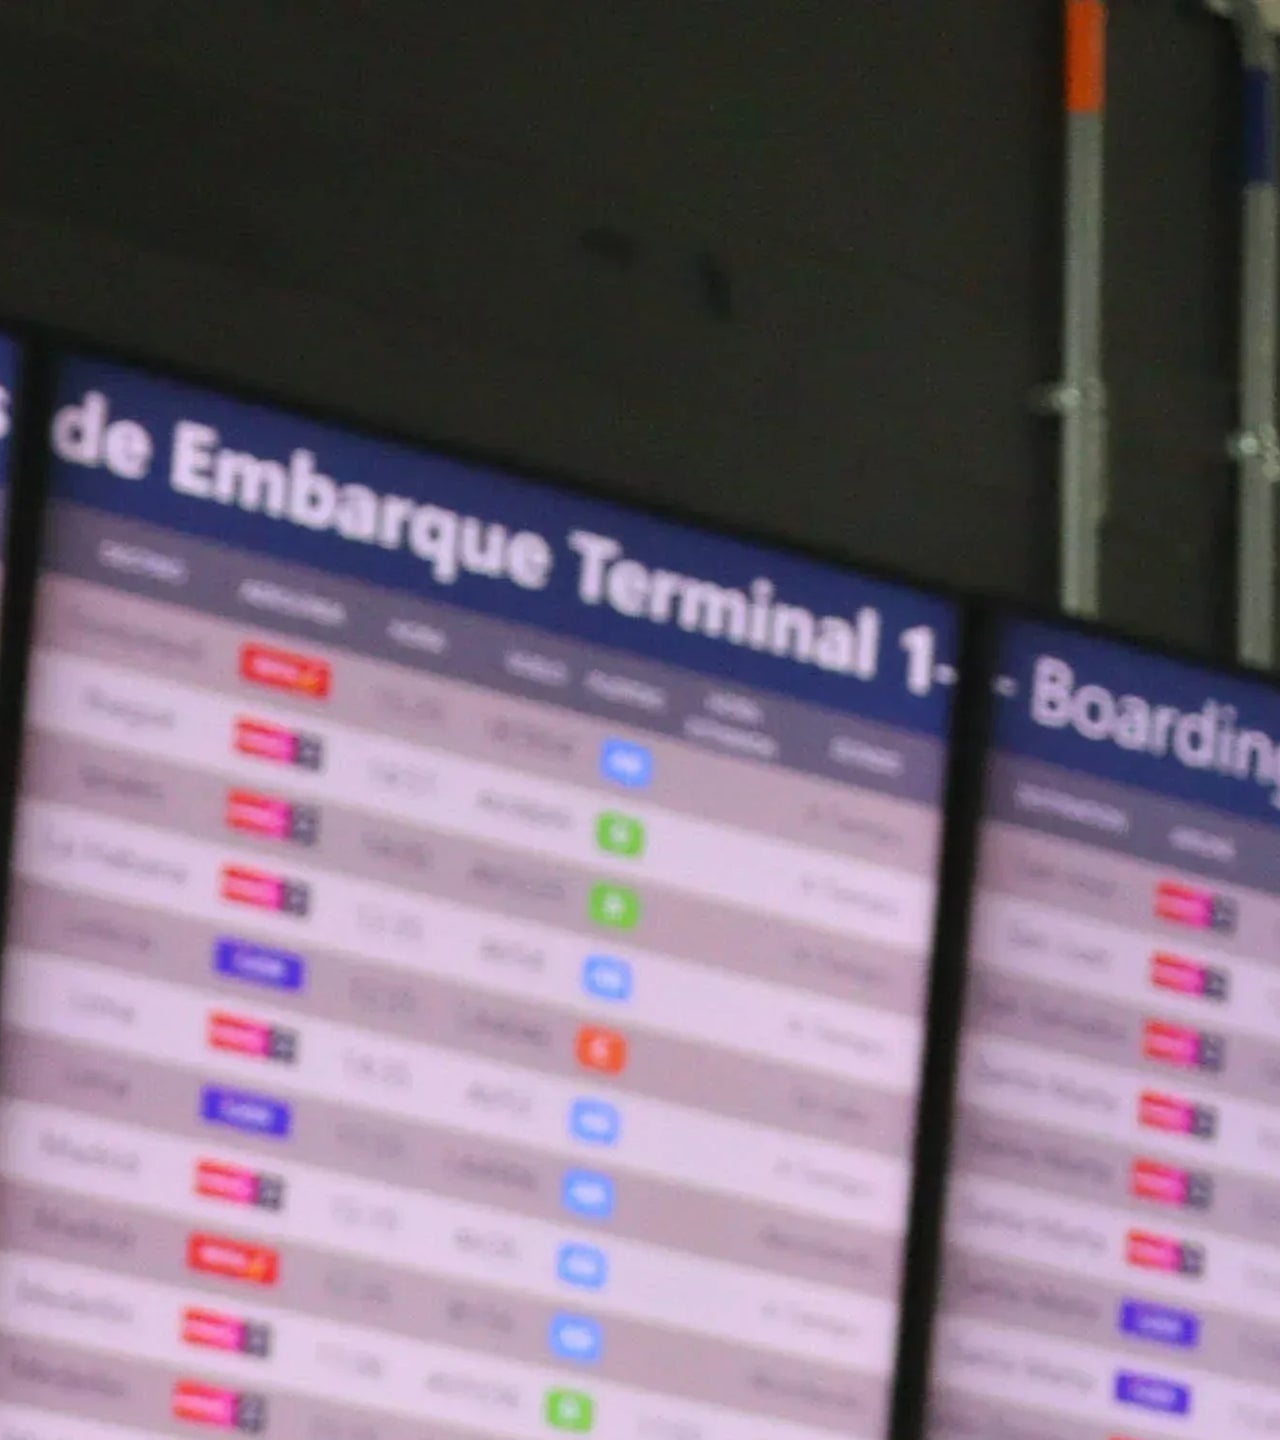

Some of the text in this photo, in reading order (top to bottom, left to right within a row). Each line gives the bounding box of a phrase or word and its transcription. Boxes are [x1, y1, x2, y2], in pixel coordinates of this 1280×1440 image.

[52, 390, 152, 480] de
[171, 419, 551, 588] Embarque
[567, 528, 882, 680] Terminal
